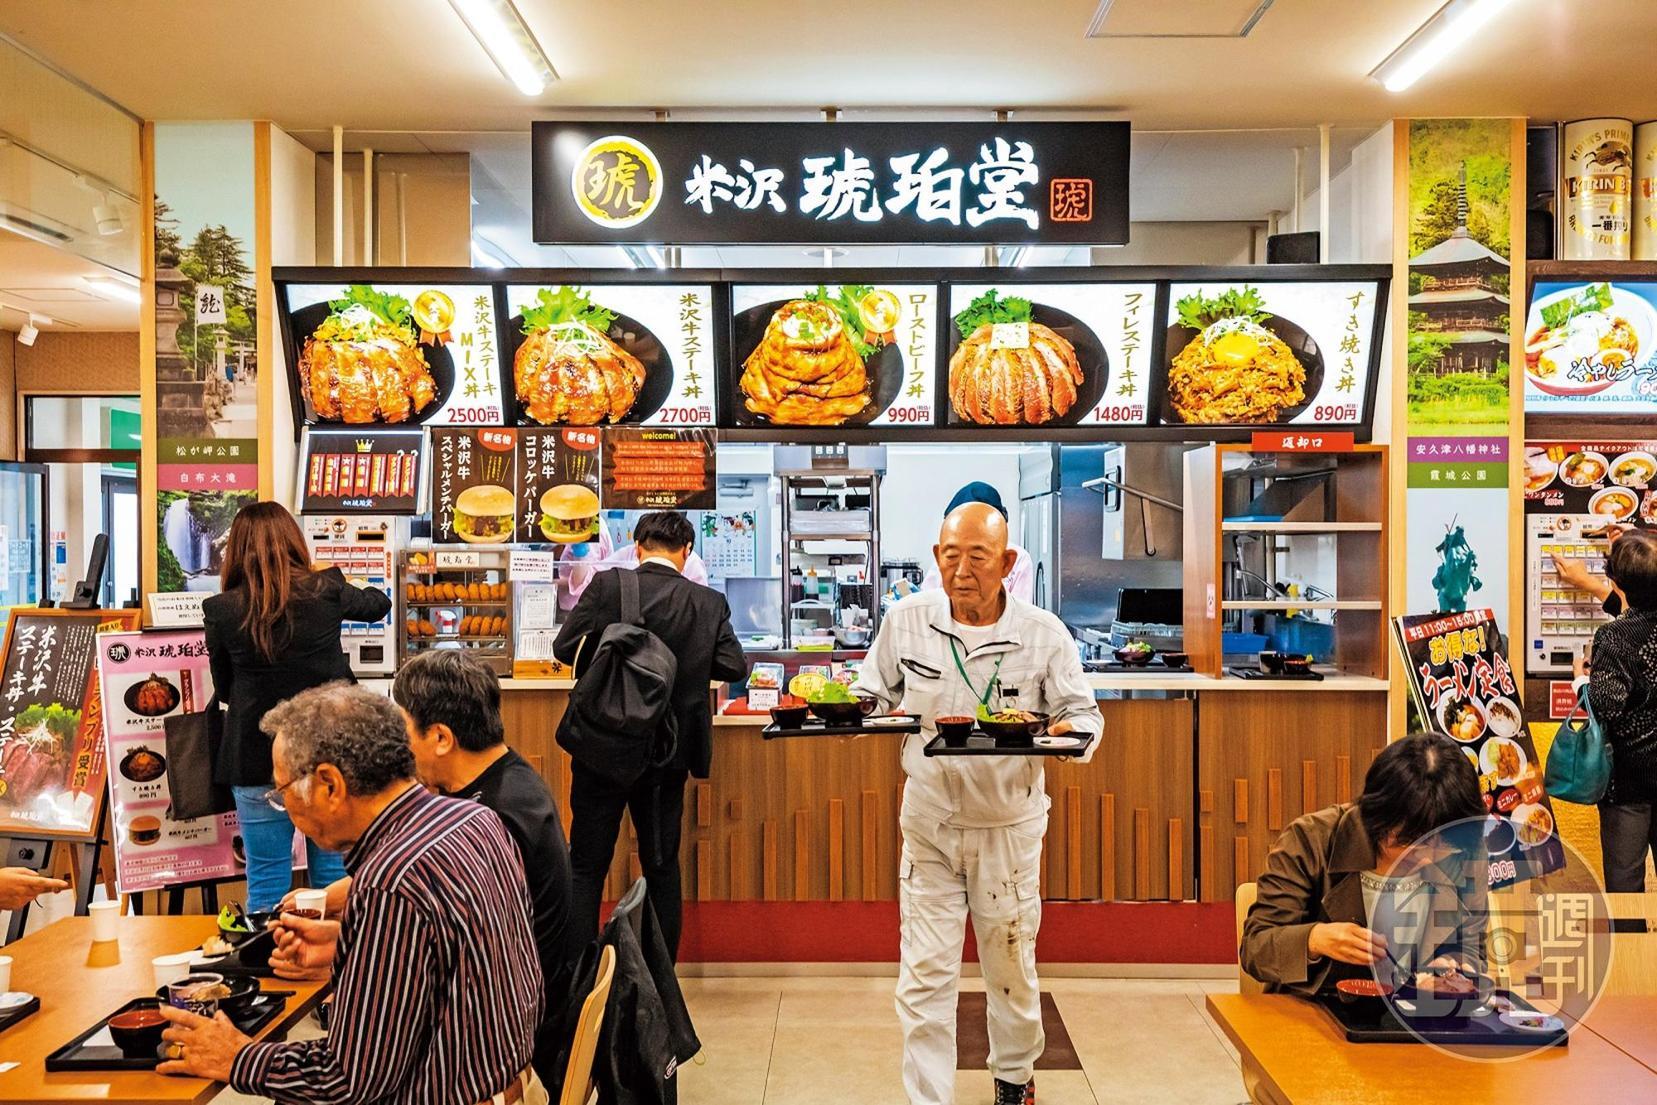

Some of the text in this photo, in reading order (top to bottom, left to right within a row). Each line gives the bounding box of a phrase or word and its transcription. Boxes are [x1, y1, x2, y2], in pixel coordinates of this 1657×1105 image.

[459, 332, 480, 398] MIX丼
[473, 294, 498, 397] 米沢牛ステーキ
[680, 293, 705, 398] 米沢牛ステーキ丼
[905, 293, 928, 399] ローストビーフ丼
[1115, 292, 1143, 397] フィレステーキ丼
[1335, 291, 1366, 394] すき焼き丼
[447, 407, 500, 423] 2500円
[659, 407, 711, 423] 2700円
[887, 407, 930, 423] 990円
[1094, 406, 1143, 421] 1480円
[1314, 405, 1357, 421] 890円
[176, 445, 240, 457] 松が岬公園
[457, 435, 472, 480] 米沢牛
[482, 432, 512, 445] 新名物
[541, 434, 555, 480] 米沢牛
[567, 431, 596, 444] 新名物
[1416, 444, 1501, 455] 安久津八幡神社
[180, 472, 237, 484] 白布大滝
[439, 435, 453, 540] スペシャルメンチバーガー
[524, 435, 537, 538] コロッケバーガー
[1430, 469, 1487, 481] 霞城公園
[27, 624, 57, 697] 米沢牛
[1419, 651, 1516, 710] ラーメン定食
